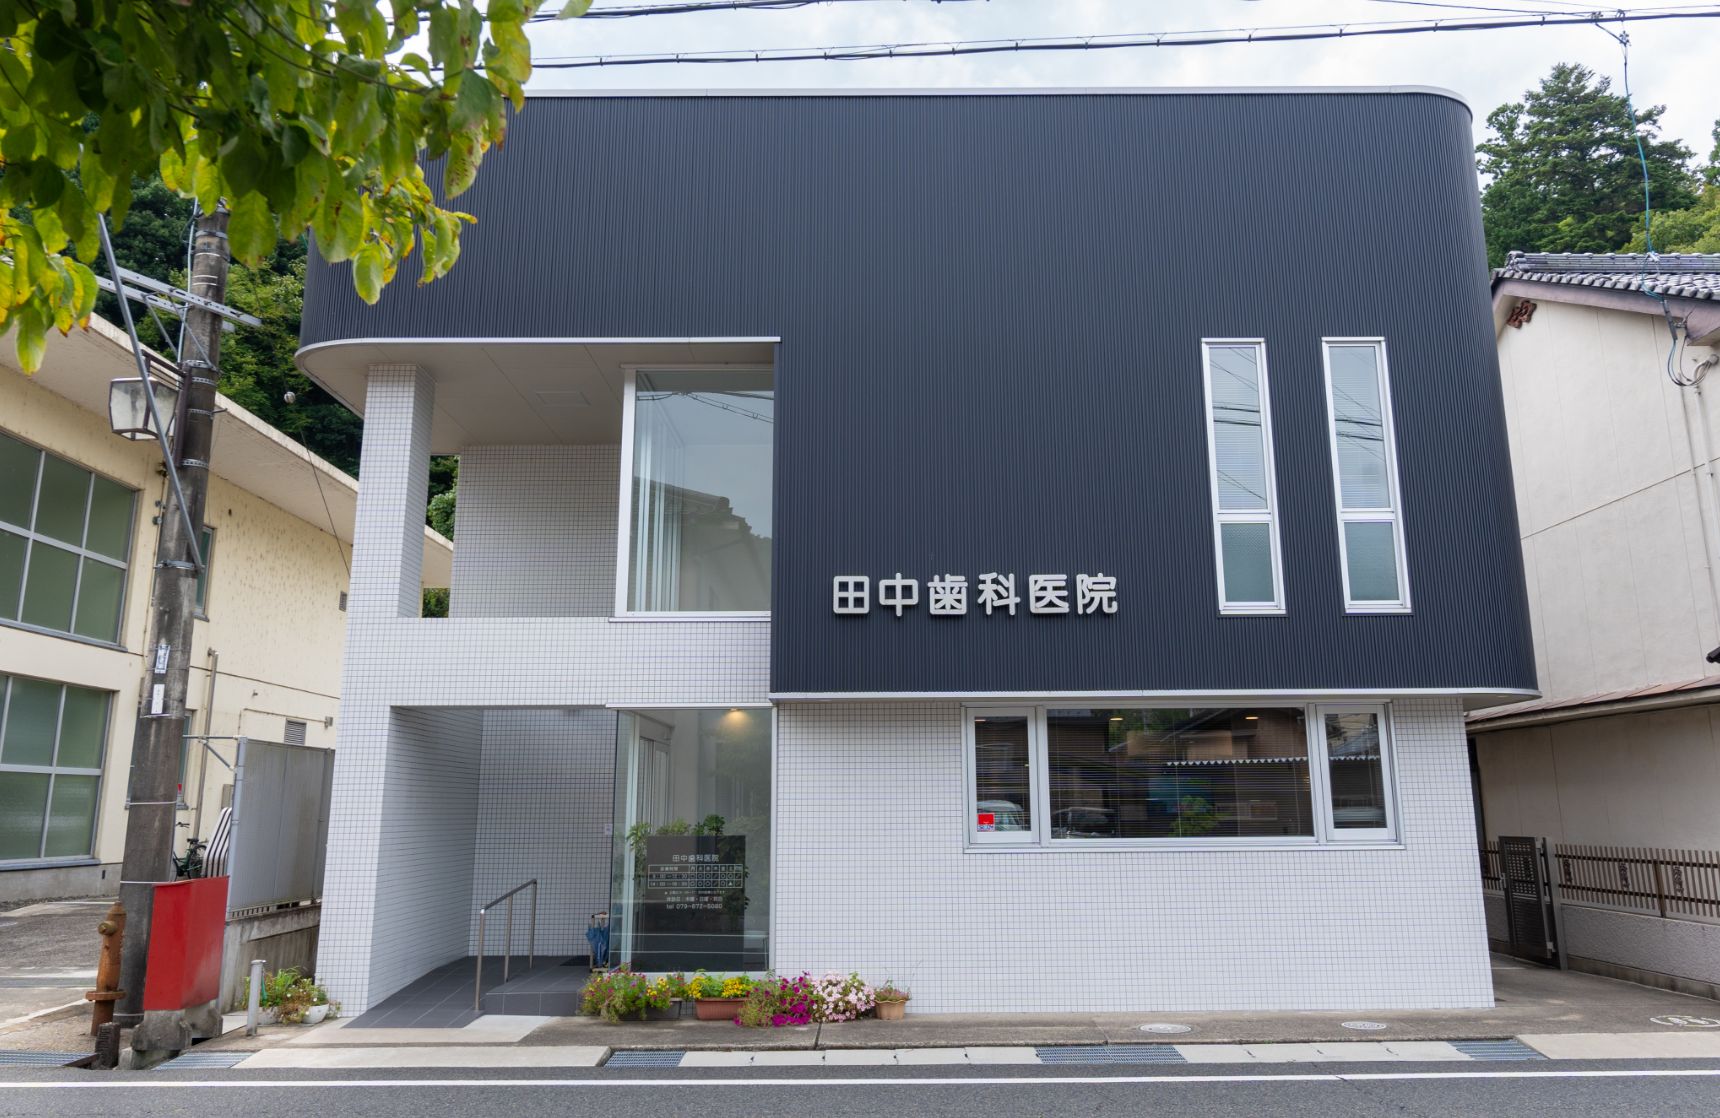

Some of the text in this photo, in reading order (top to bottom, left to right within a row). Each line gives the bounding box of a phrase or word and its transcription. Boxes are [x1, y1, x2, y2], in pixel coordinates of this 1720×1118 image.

[833, 572, 1118, 616] 田中歯科医院
[672, 854, 719, 862] 田中歯科医院
